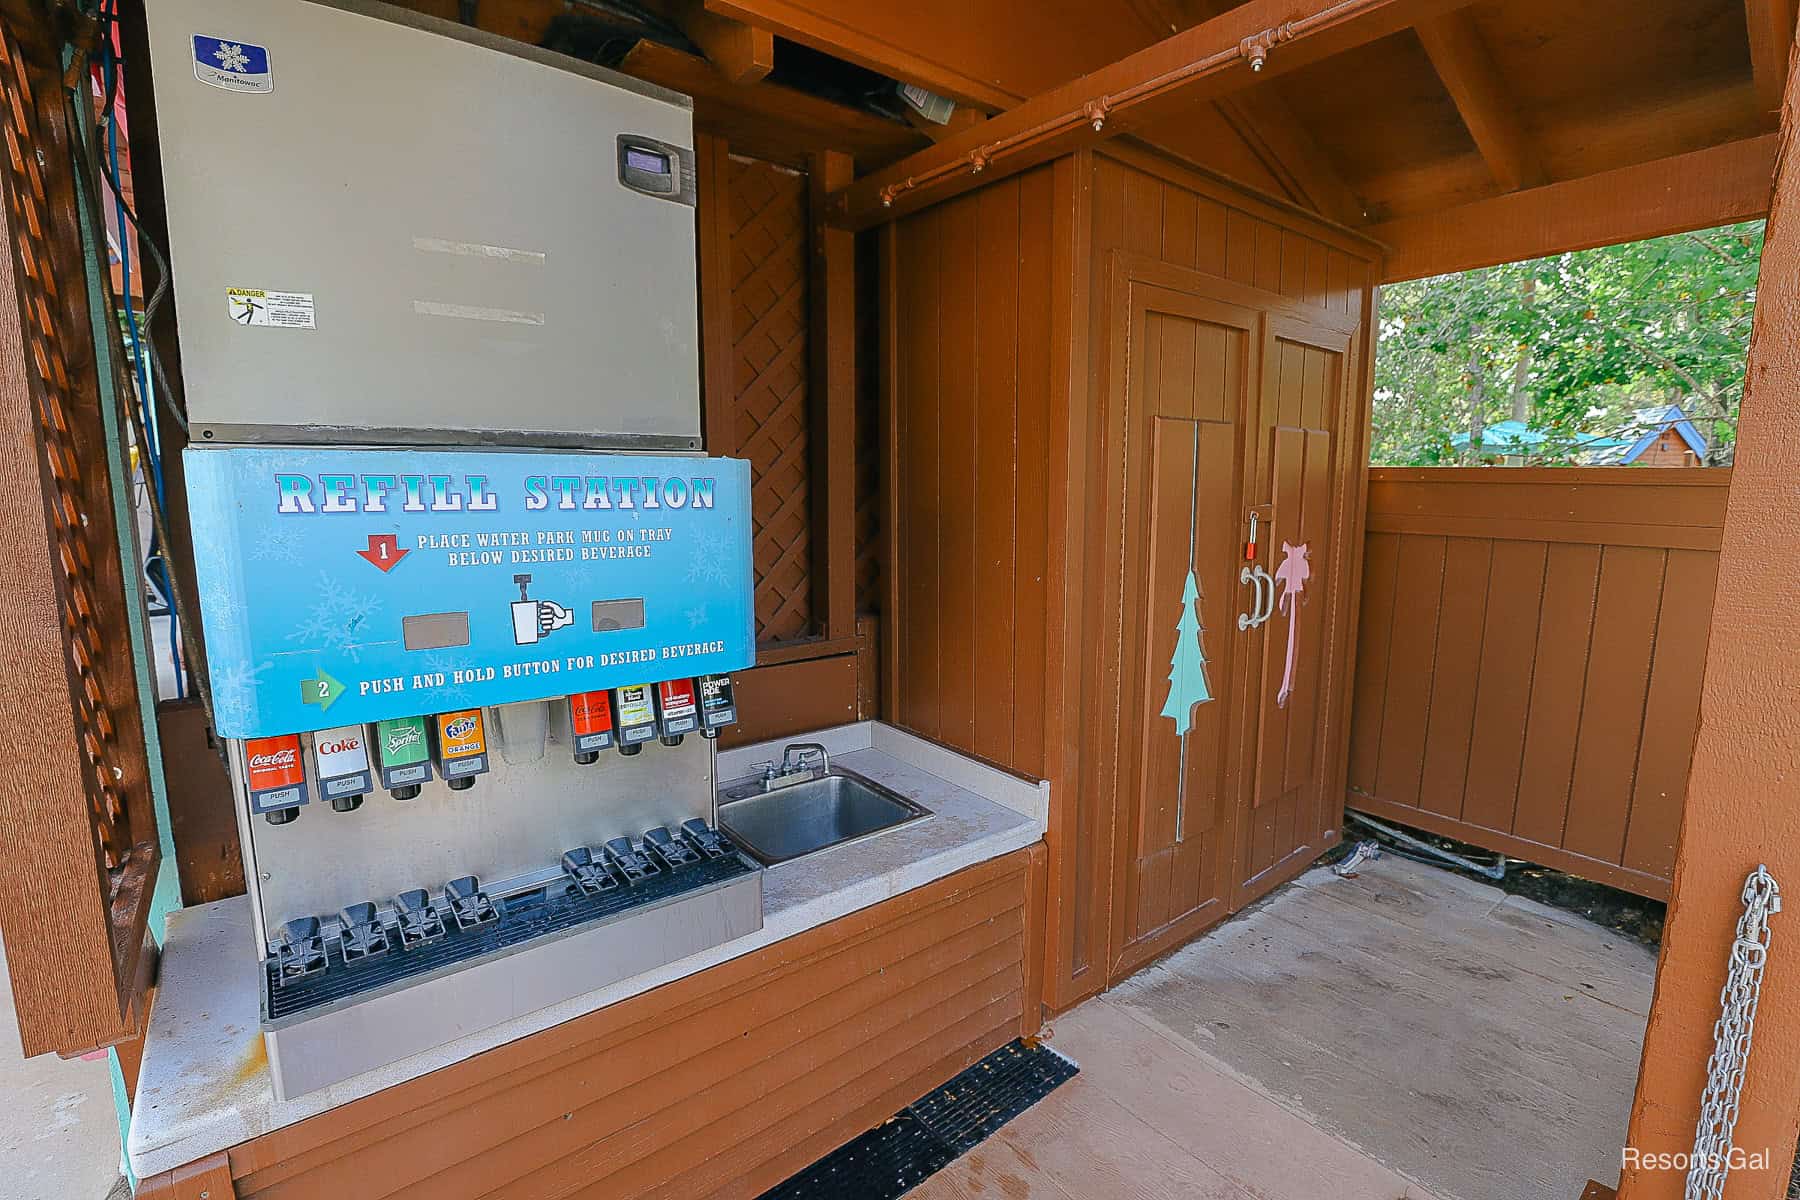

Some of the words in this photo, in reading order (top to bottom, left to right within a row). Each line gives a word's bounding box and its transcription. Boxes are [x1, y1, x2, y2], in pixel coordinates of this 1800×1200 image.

[236, 288, 265, 298] DANGER
[275, 473, 497, 513] REFILL
[524, 475, 715, 510] STATION
[417, 533, 471, 550] PLACE
[477, 531, 530, 547] WATER
[536, 530, 575, 545] PARK
[581, 529, 610, 543] MUG
[617, 528, 634, 542] ON
[639, 527, 673, 542] TRAY
[379, 542, 389, 560] 1
[448, 551, 504, 567] BELOW
[511, 548, 574, 563] DESIRED
[581, 545, 651, 560] BEVERAGE
[359, 677, 405, 696] PUSH
[412, 673, 445, 690] AND
[453, 667, 495, 684] HOLD
[503, 658, 561, 678] BUTTON
[566, 655, 595, 671] FOR
[600, 648, 657, 667] DESIRED
[662, 640, 725, 659] BEVERAGE
[318, 681, 330, 698] 2
[702, 677, 730, 689] POWER
[445, 720, 476, 738] Fanta
[319, 738, 360, 755] Coke
[389, 733, 419, 748] Sprite
[447, 742, 481, 753] ORANGE
[250, 748, 297, 768] Coca-Cola
[399, 767, 418, 777] PUSH
[336, 779, 356, 787] PUSH
[270, 790, 290, 800] PUSH
